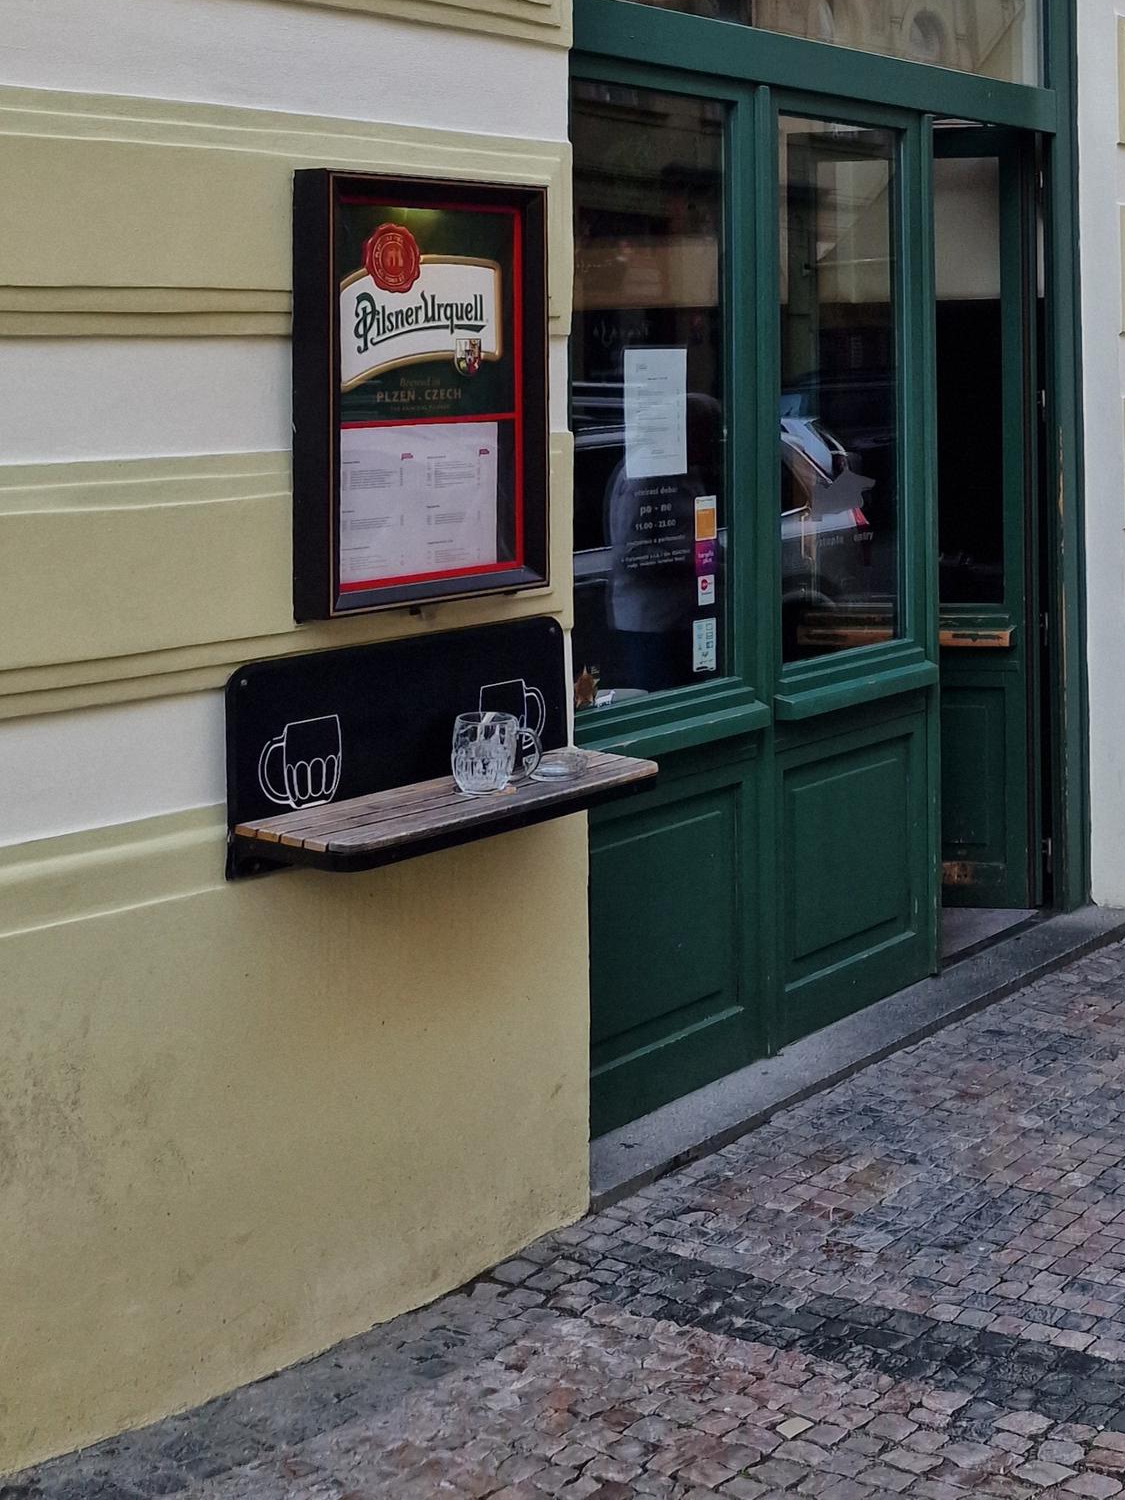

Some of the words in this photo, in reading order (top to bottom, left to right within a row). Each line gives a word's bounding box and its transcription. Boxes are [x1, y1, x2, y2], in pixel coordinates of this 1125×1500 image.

[354, 291, 423, 354] Pilsner
[420, 290, 484, 335] Urquell
[424, 388, 462, 400] CZECH
